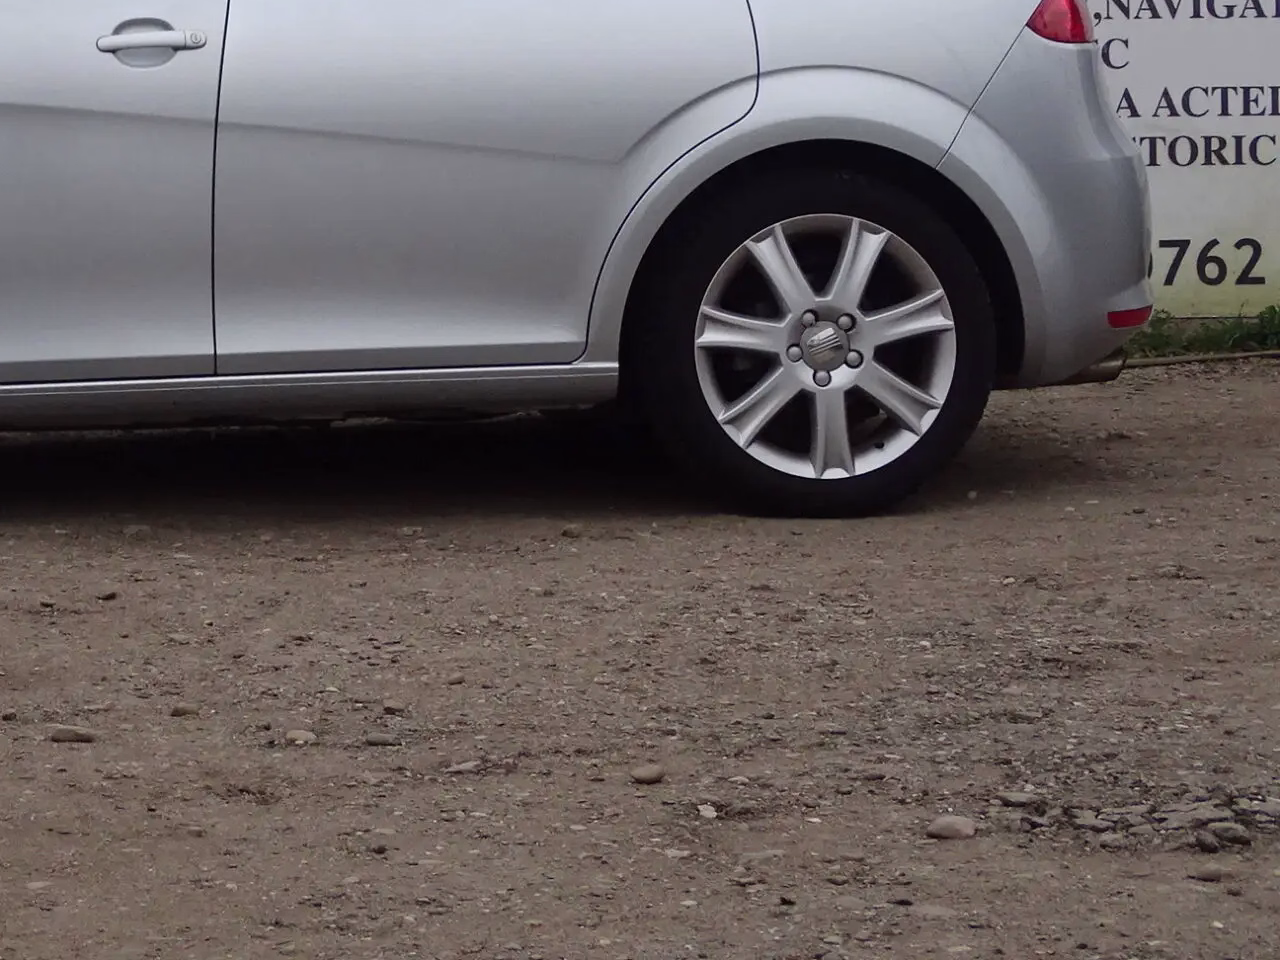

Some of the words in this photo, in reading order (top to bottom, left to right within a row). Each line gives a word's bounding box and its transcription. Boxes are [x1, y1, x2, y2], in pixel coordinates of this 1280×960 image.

[1094, 38, 1129, 70] C
[1132, 135, 1277, 167] TORIC
[1147, 238, 1266, 287] 762
